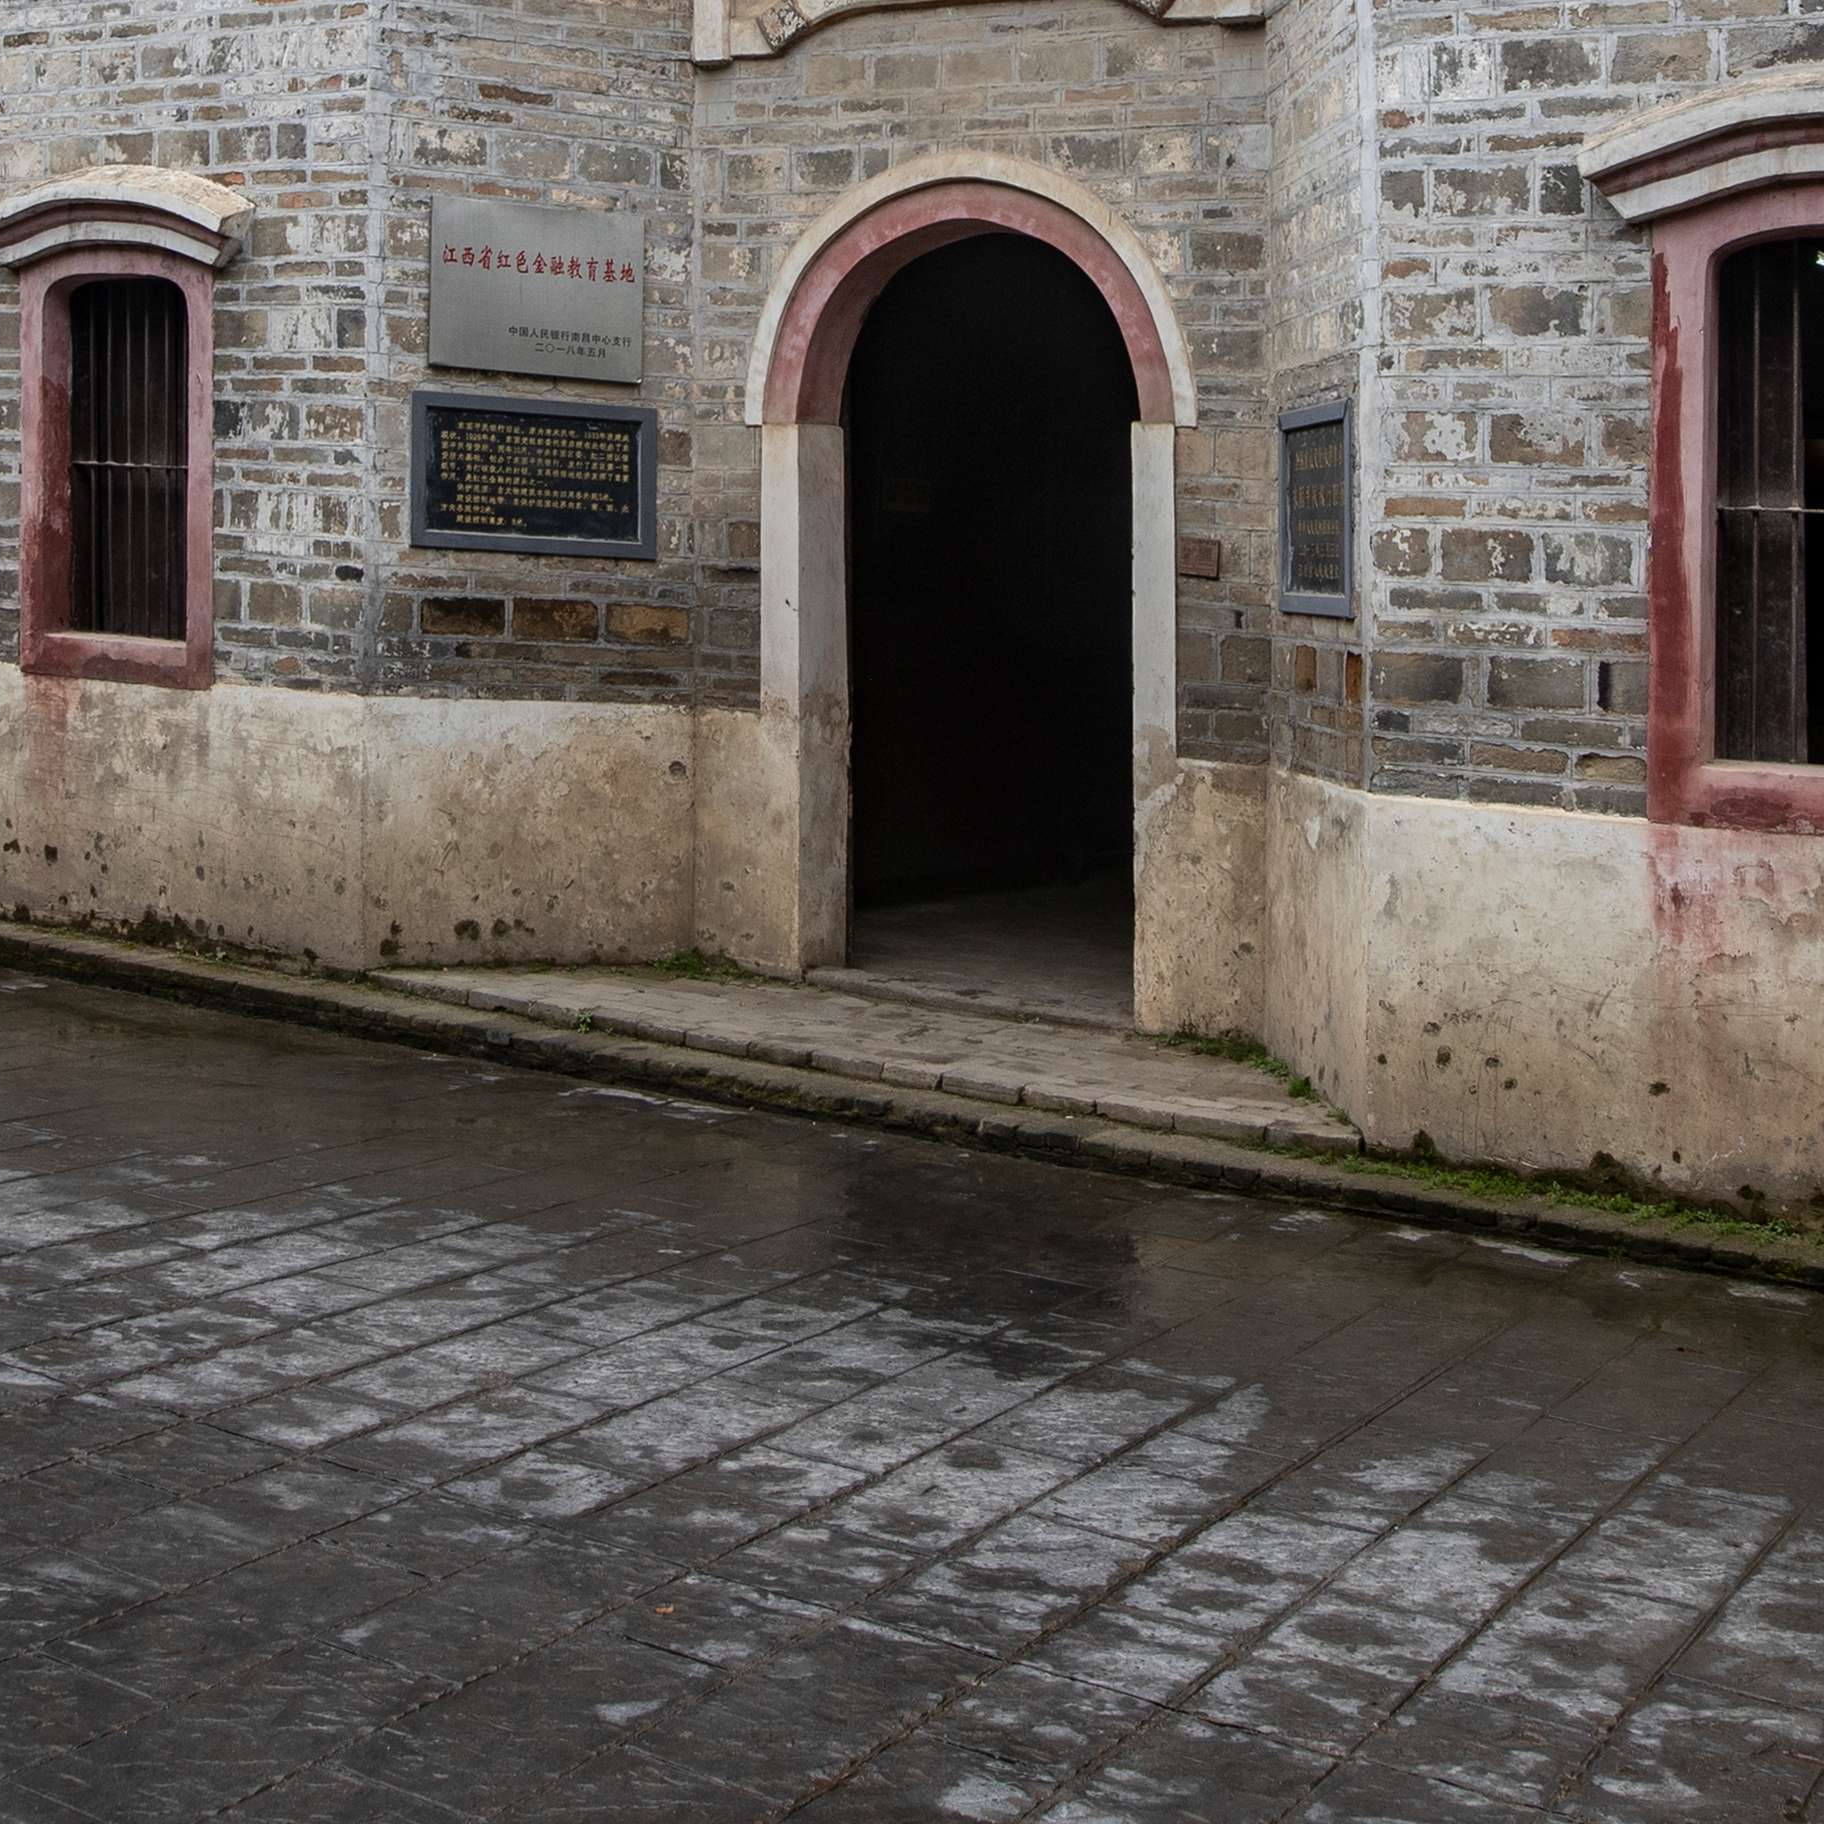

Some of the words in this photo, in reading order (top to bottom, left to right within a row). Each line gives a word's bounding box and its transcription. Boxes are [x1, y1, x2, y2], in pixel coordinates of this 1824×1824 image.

[442, 243, 636, 284] 江西省红色金融教育基地
[508, 325, 632, 347] 中国人民银行南昌中心支行
